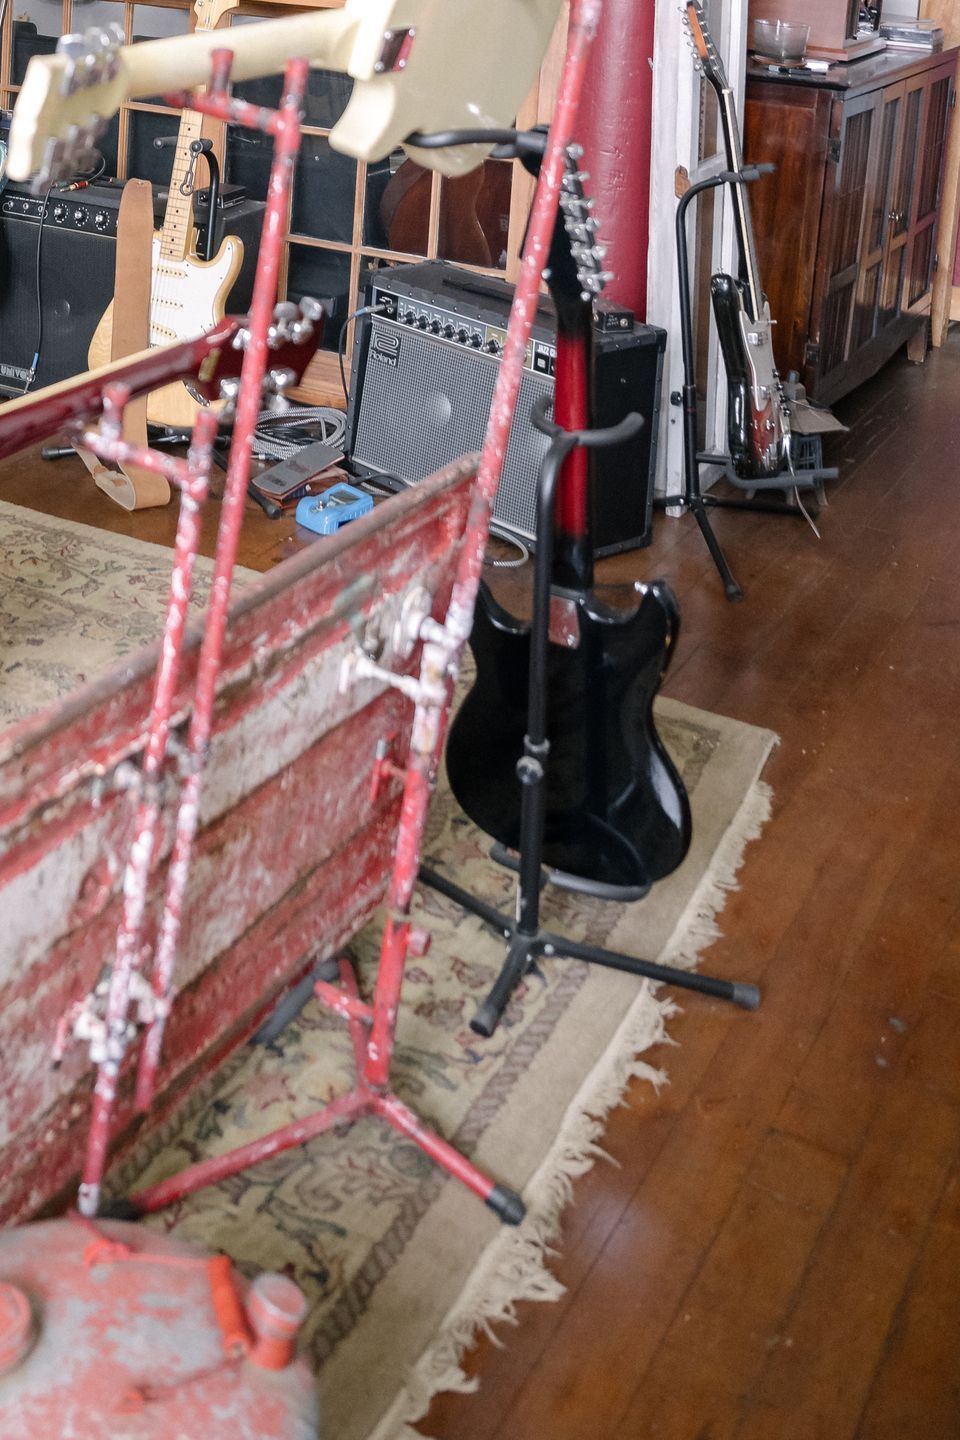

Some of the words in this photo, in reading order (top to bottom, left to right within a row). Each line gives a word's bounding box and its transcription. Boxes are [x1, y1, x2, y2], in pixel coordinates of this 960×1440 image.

[537, 344, 550, 356] JAZZ
[370, 350, 396, 366] Roland
[1, 365, 31, 380] UNIVO
